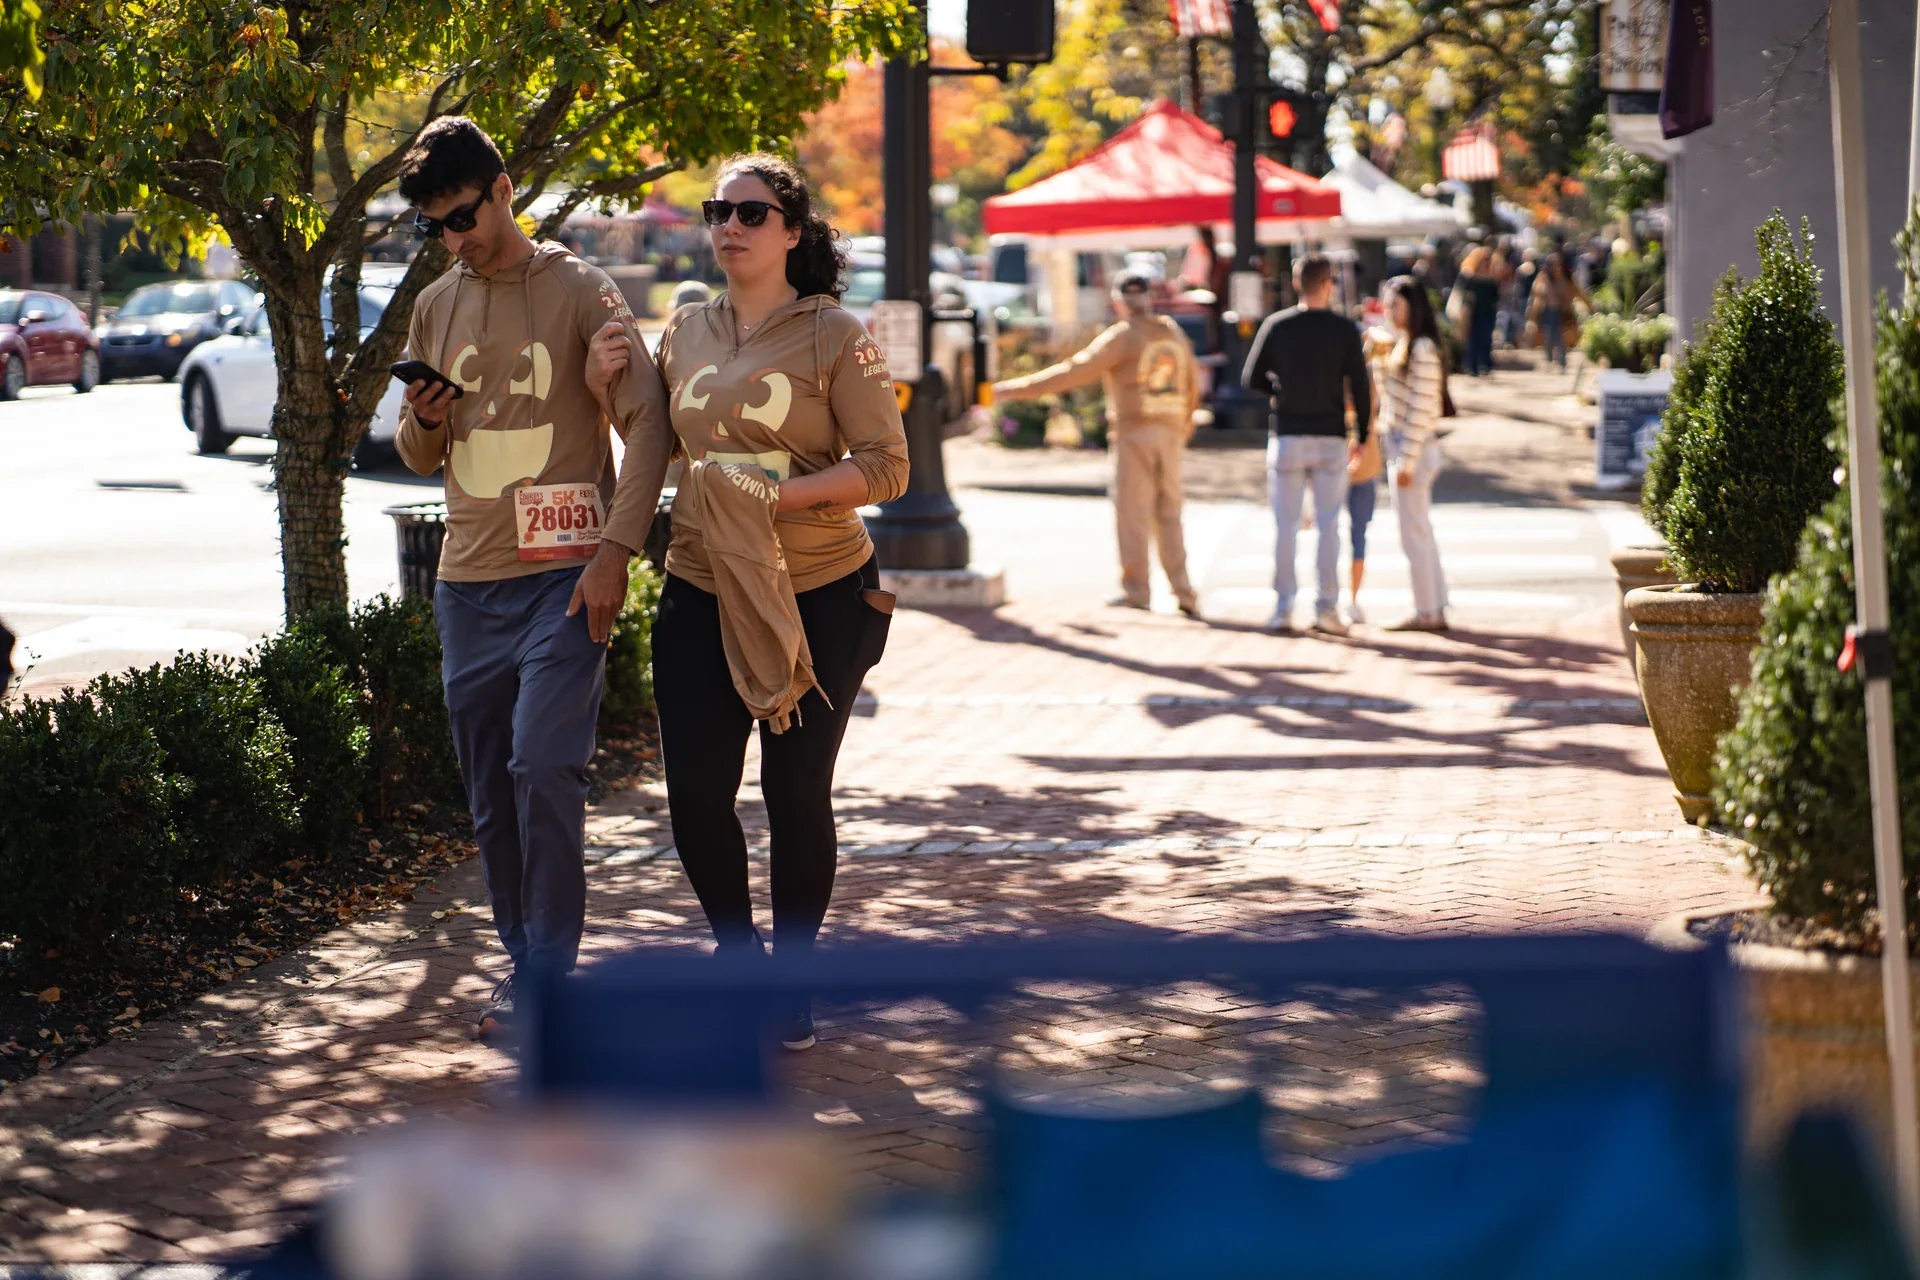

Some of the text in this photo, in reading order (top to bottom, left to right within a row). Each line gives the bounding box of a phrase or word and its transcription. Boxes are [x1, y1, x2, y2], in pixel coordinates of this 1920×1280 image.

[854, 334, 867, 348] THE
[854, 345, 887, 365] 202
[863, 362, 889, 378] LEGEN
[551, 490, 576, 506] 5K
[526, 504, 599, 532] 28031
